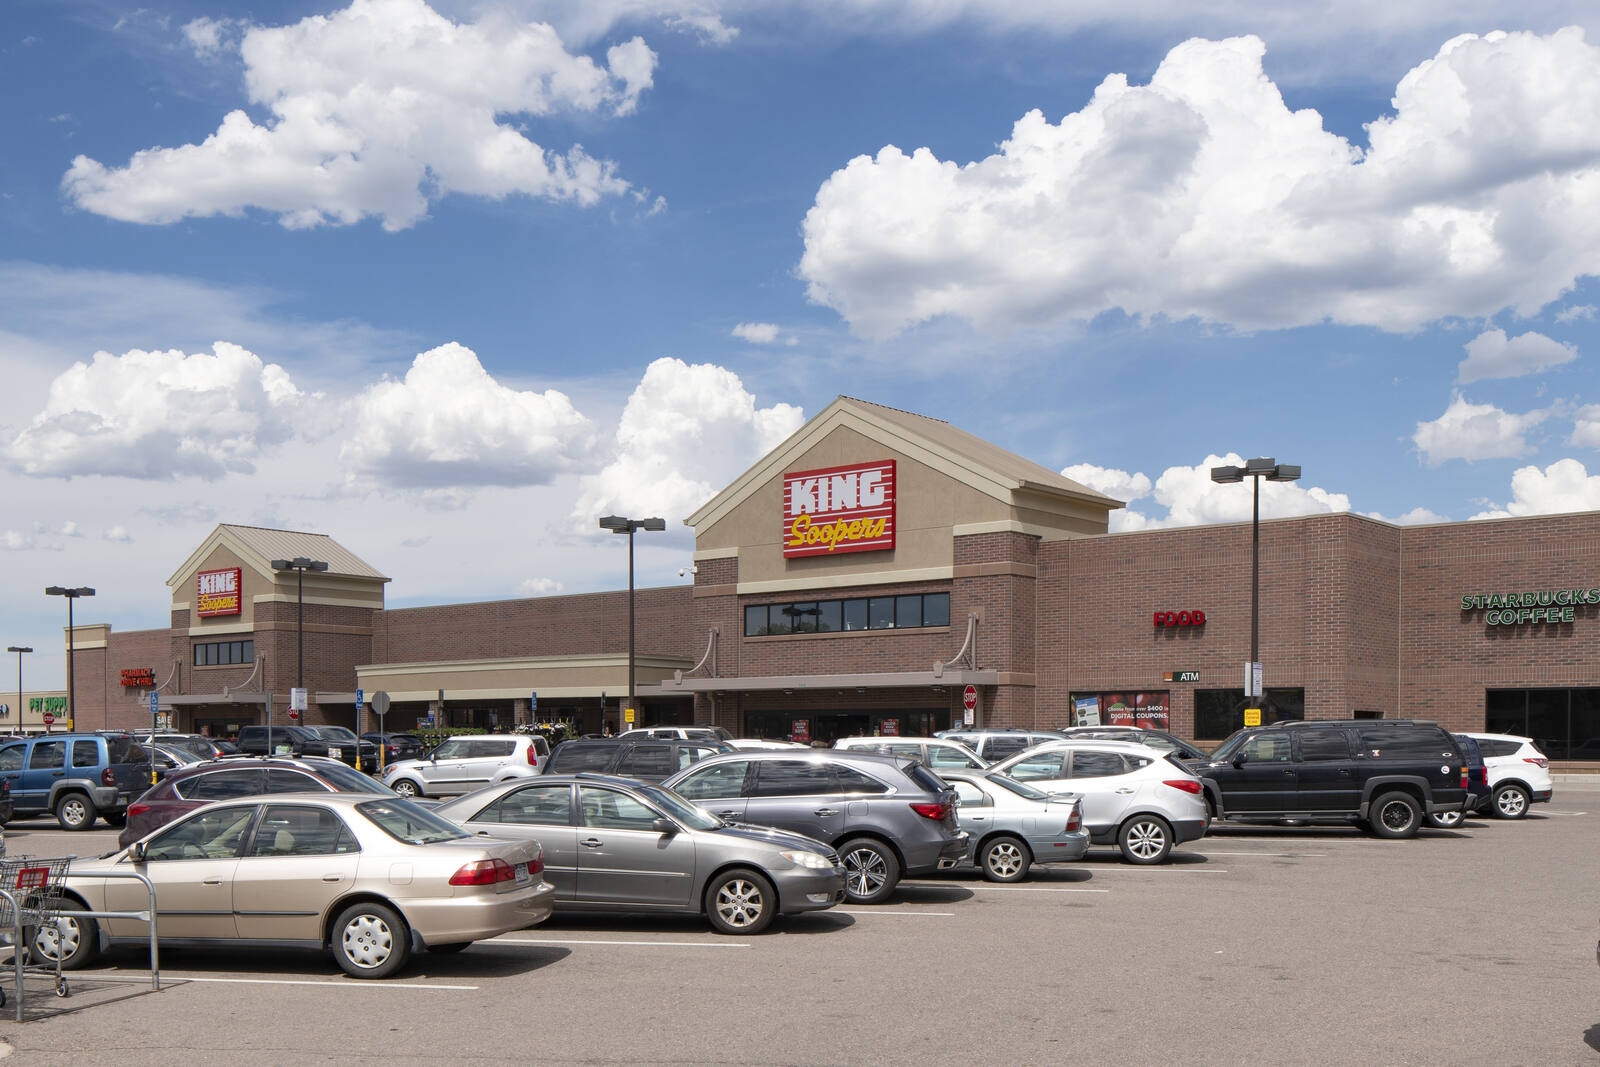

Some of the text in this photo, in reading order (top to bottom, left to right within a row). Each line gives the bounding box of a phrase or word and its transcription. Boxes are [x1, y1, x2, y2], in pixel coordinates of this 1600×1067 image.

[790, 470, 885, 516] KING
[788, 514, 887, 551] Soopers
[200, 573, 235, 594] KING
[200, 594, 236, 614] Soopers
[1461, 588, 1600, 609] STARBUCKS
[1153, 610, 1204, 627] FOOD
[1485, 607, 1575, 625] COFFEE
[120, 668, 152, 677] PHARMACY
[1180, 672, 1199, 681] ATM
[120, 677, 152, 687] DRIVE THRU
[30, 698, 43, 712] PET
[965, 692, 976, 702] STOP
[156, 716, 172, 724] SALE
